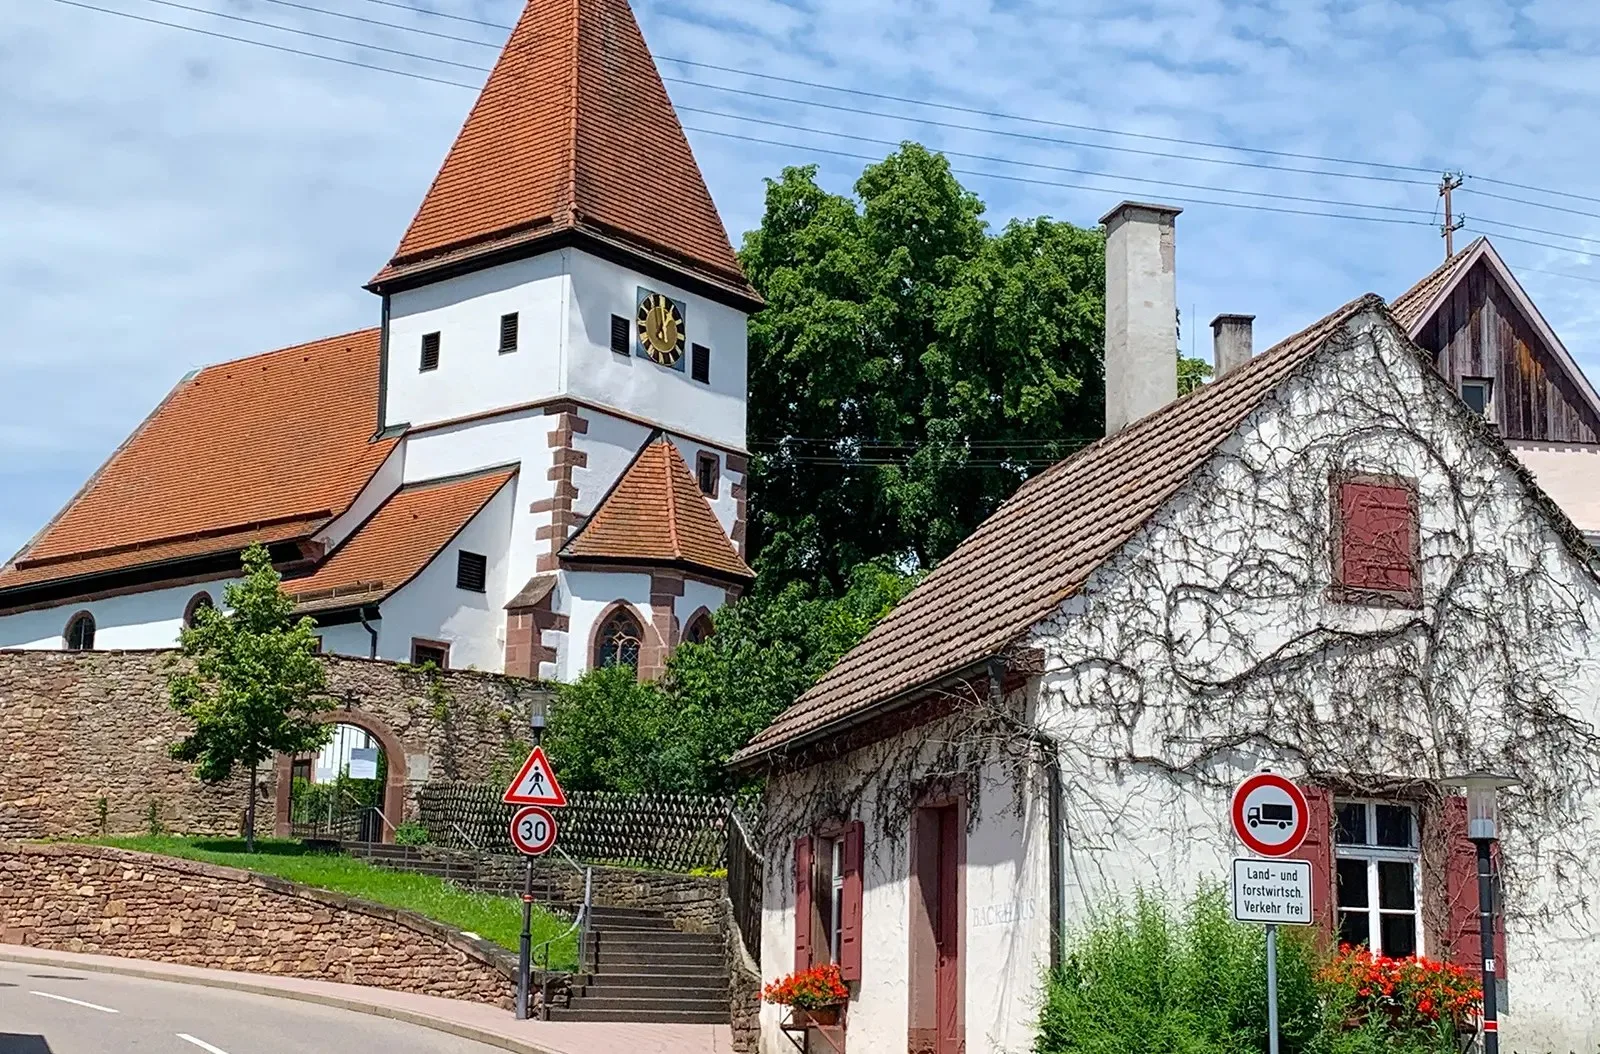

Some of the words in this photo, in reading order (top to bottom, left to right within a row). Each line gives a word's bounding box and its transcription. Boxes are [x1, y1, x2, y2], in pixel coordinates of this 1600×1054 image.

[521, 820, 547, 841] 30
[1247, 867, 1276, 880] Land-
[1280, 870, 1298, 881] und
[1243, 883, 1304, 898] forstwirtsch.
[1244, 900, 1281, 914] Verkehr
[1286, 902, 1303, 915] frei
